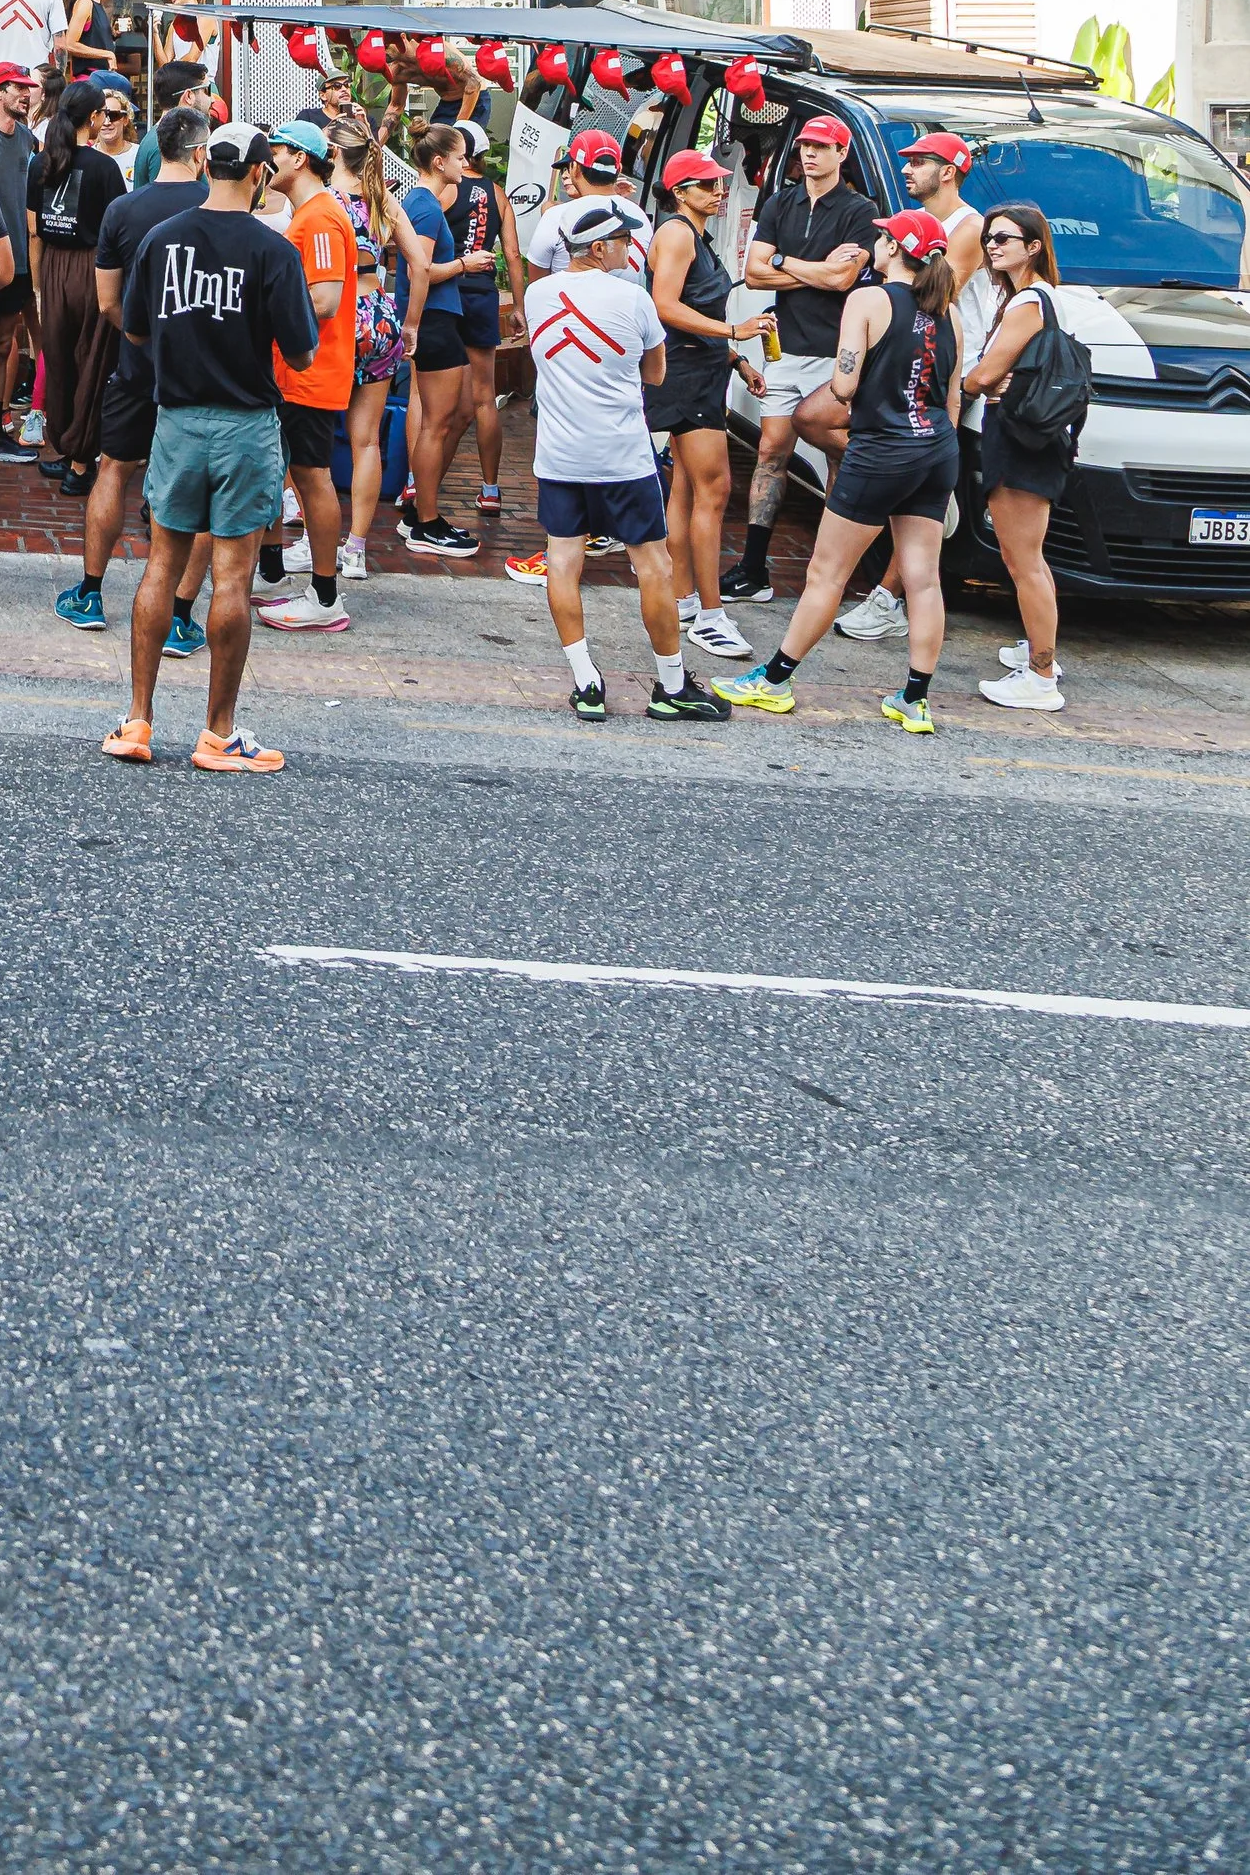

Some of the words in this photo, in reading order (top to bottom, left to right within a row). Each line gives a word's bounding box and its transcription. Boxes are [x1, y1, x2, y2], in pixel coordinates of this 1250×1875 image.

[510, 194, 538, 205] TEMPLE
[903, 357, 923, 430] modern
[1199, 521, 1250, 541] JBB3
